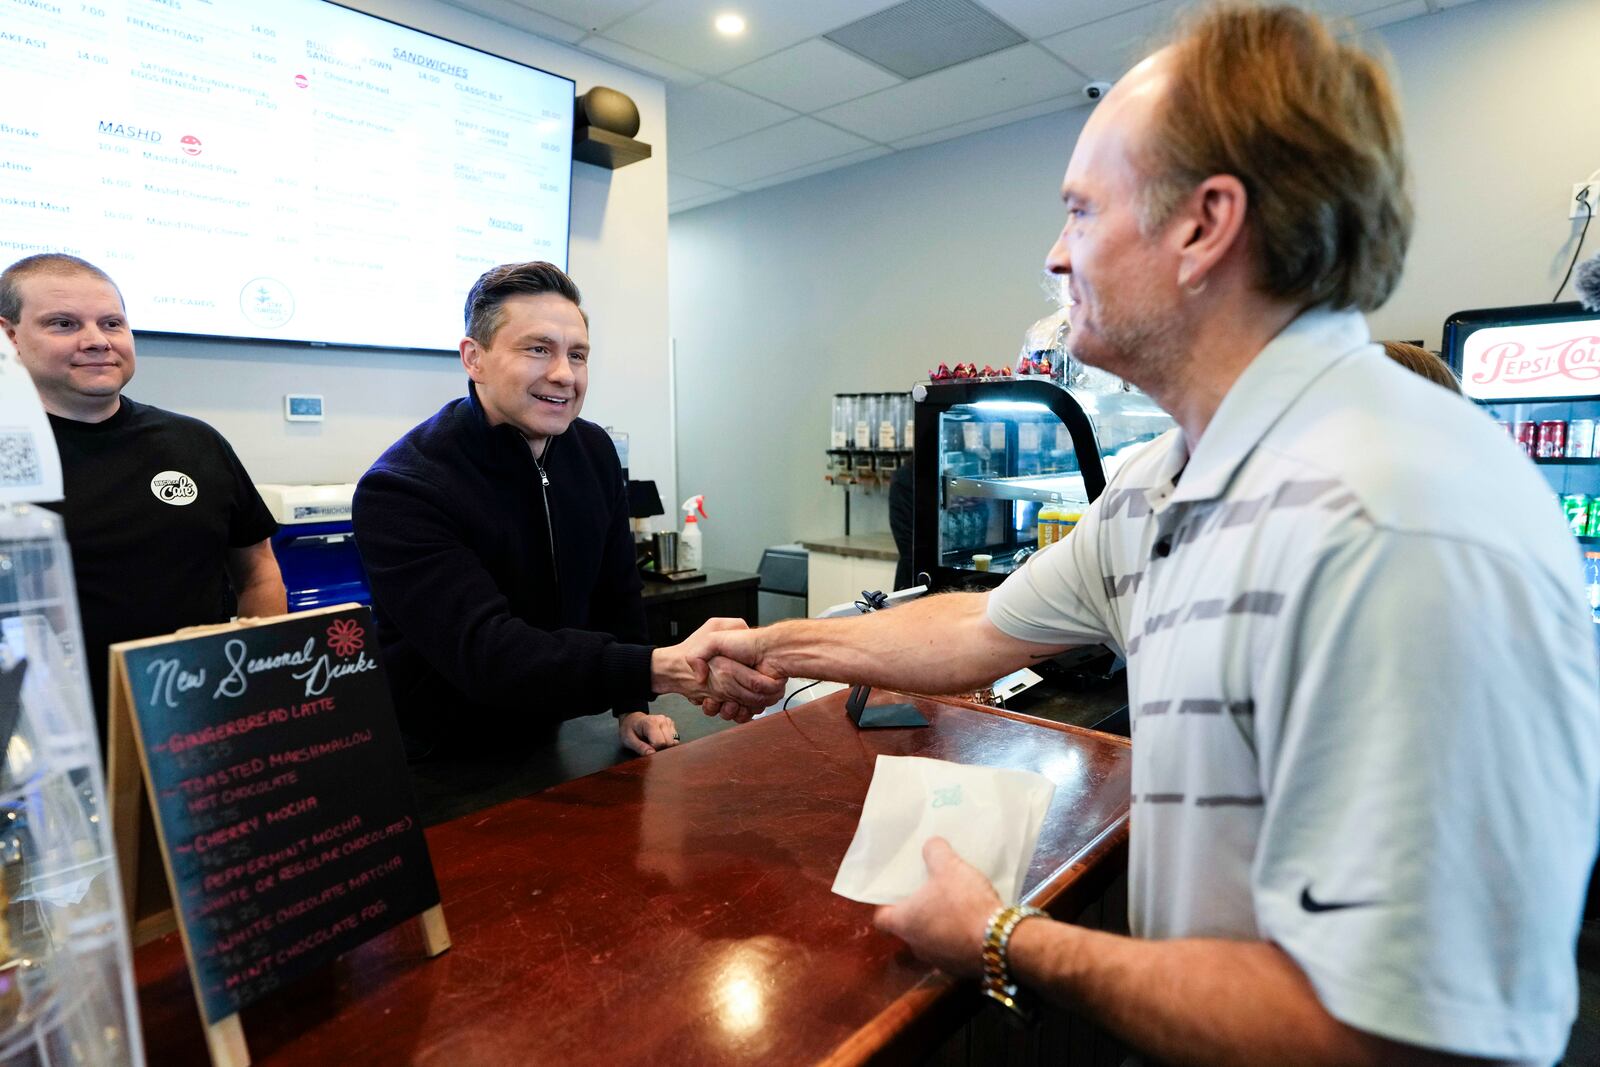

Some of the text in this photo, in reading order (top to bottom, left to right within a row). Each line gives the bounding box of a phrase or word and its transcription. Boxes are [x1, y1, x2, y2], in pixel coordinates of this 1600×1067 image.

[126, 16, 170, 36] FRENCH
[172, 27, 204, 44] TOAST
[130, 69, 211, 94] EGGS BENEDICT
[368, 58, 392, 71] OWN
[391, 46, 468, 79] SANDWICHES
[455, 82, 503, 102] CLASSIC BLT
[0, 123, 39, 139] Broke
[97, 120, 162, 143] MASHD
[146, 658, 206, 707] New
[213, 637, 316, 698] Seasonal
[168, 696, 336, 753] GINGERBREAD LATTE
[180, 729, 372, 793] TOASTED MARSHMALLOW
[188, 770, 300, 812] HOT CHOCOLATE
[194, 796, 318, 853] CHERRY MOCHA
[204, 814, 362, 891] PEPPERMINT MOCHA
[255, 874, 276, 894] OR
[278, 847, 341, 881] REGULAR
[342, 816, 413, 856] CHOCOLATE)
[216, 855, 404, 953] WHITE CHOCOLATE MATCHA
[225, 899, 388, 989] MINT CHOCOLATE FOG
